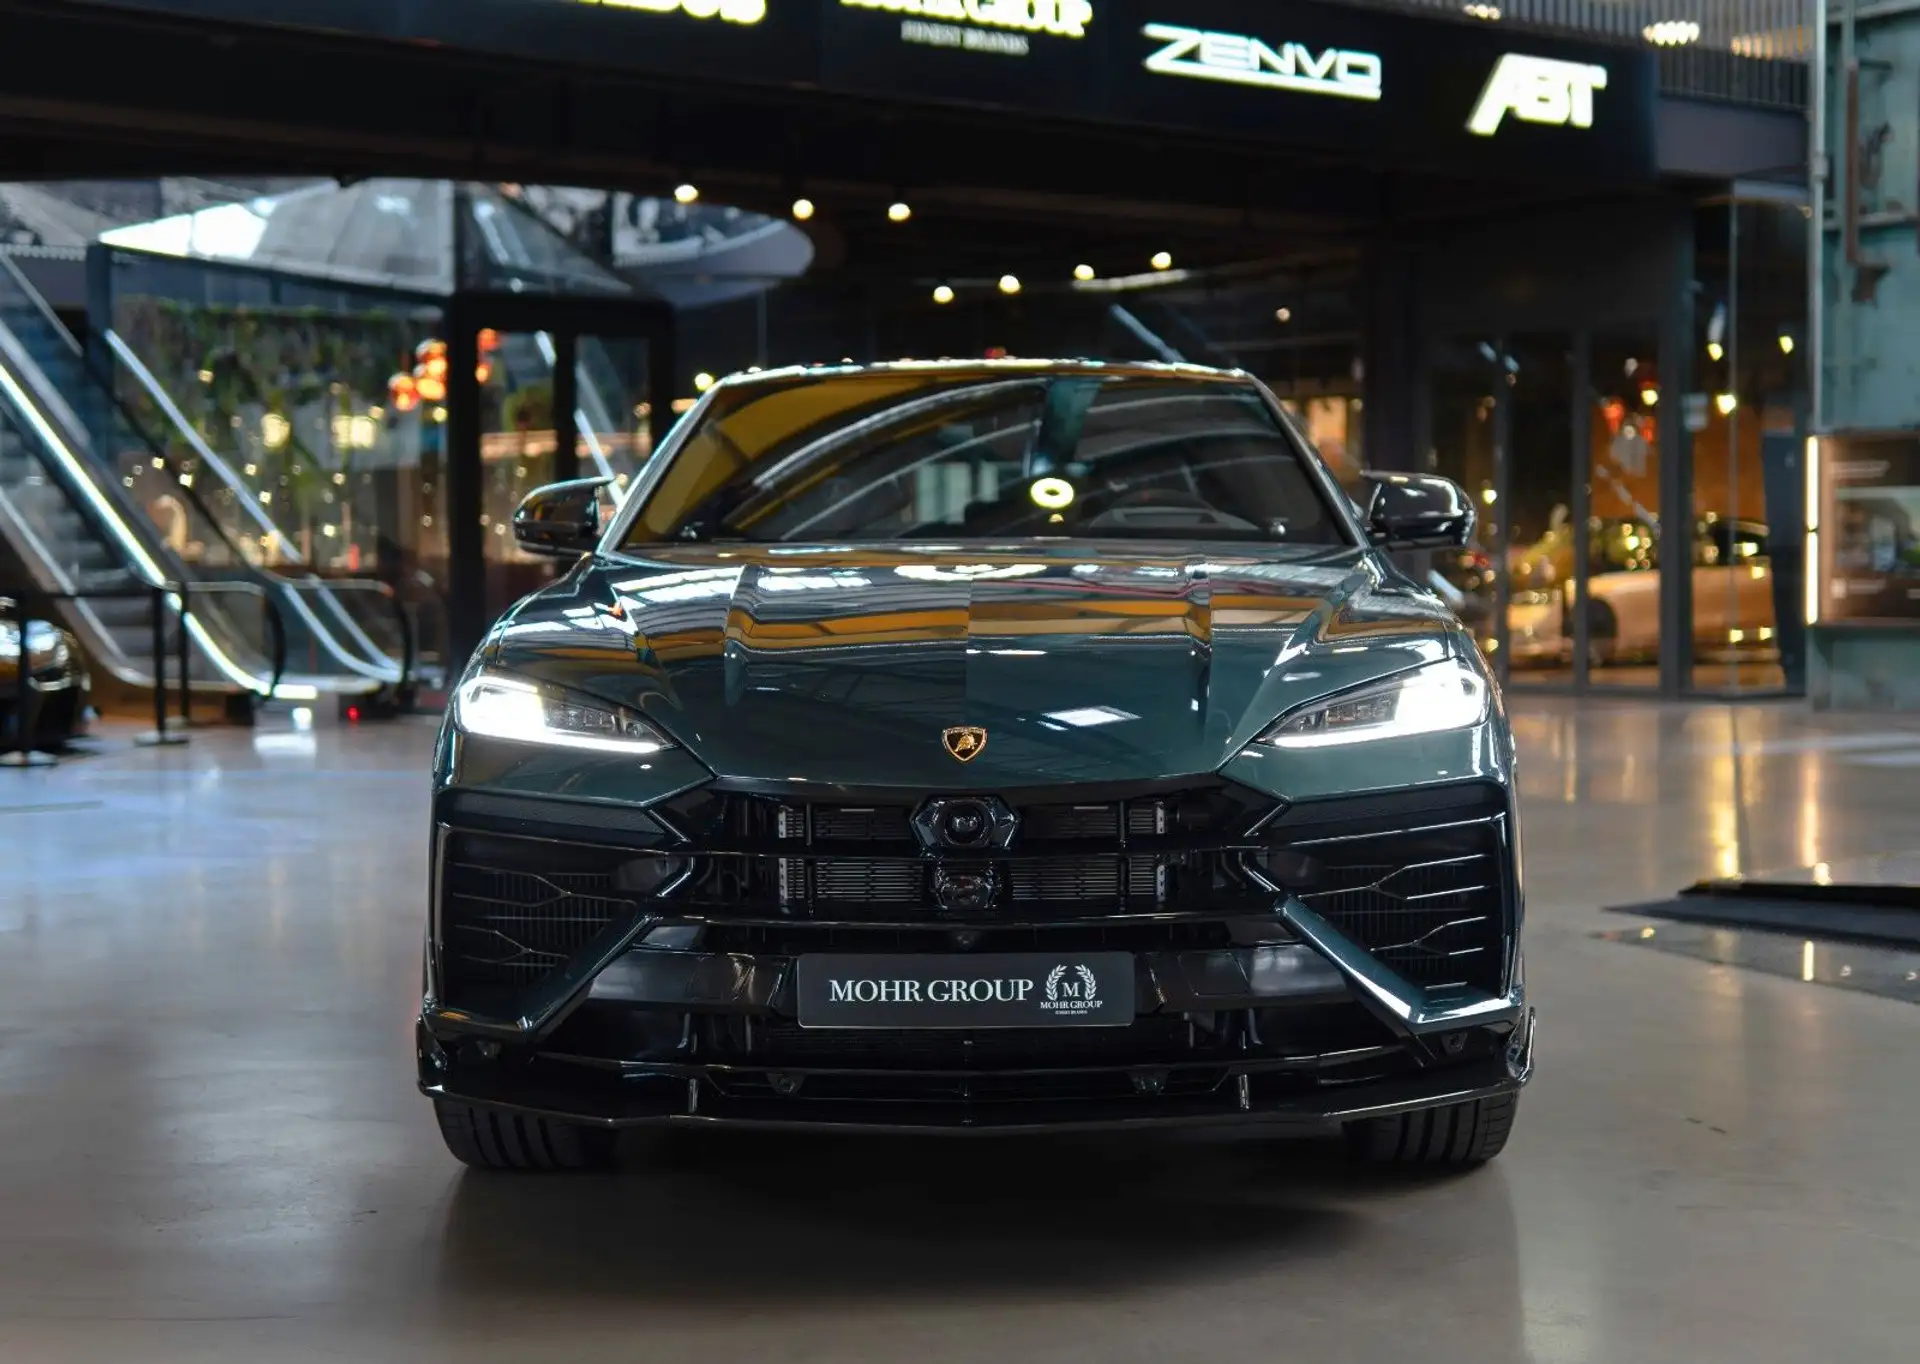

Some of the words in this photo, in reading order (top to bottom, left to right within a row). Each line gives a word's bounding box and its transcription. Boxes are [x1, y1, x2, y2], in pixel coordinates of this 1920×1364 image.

[967, 0, 1093, 38] GROUP
[1142, 22, 1382, 100] ZENVO
[1464, 52, 1607, 136] ABT
[829, 979, 924, 1002] MOHR
[927, 979, 1034, 1002] GROUP
[1040, 1000, 1070, 1009] MOHR
[1070, 1000, 1103, 1009] GROUP
[1062, 982, 1081, 997] M
